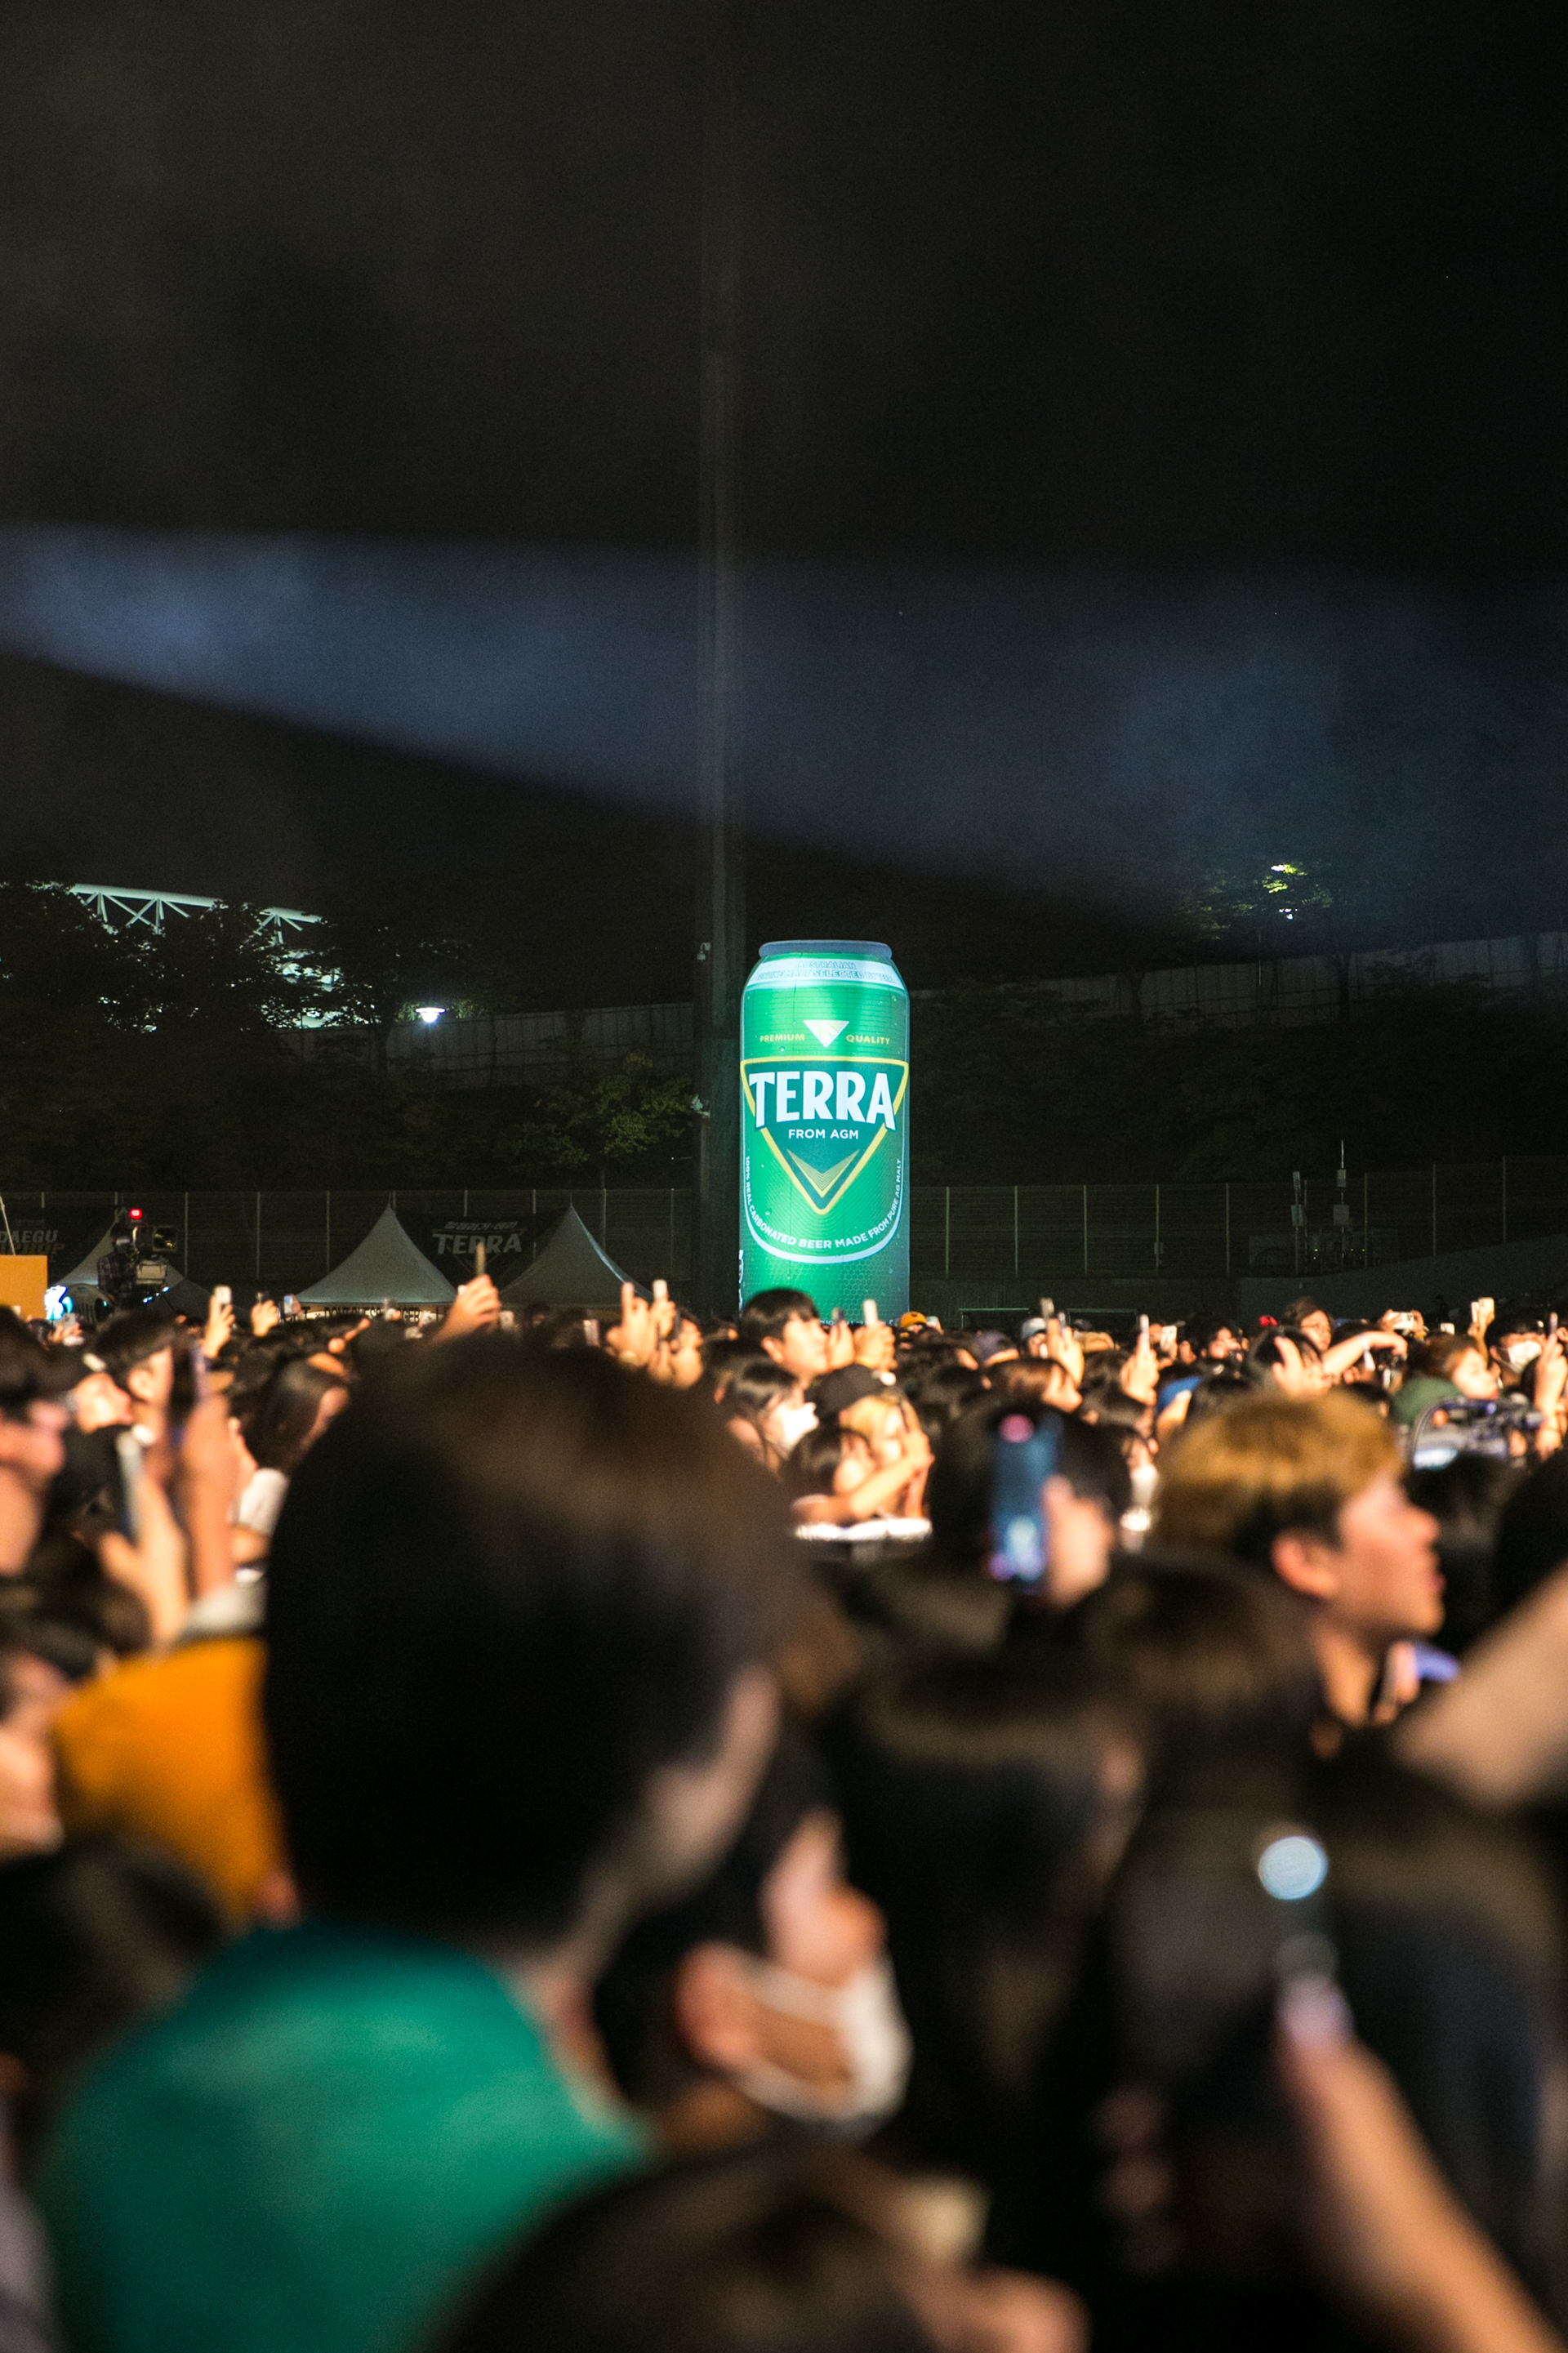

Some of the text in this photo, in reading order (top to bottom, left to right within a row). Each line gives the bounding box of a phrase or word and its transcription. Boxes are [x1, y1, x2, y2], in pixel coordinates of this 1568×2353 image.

[813, 969, 865, 979] SELECTED
[760, 1034, 890, 1045] PREMIUM QUALITY
[749, 1071, 896, 1130] TERRA
[788, 1129, 859, 1139] FROM AGM
[749, 1205, 797, 1245] CARBONATED
[799, 1238, 832, 1249] BEER
[835, 1232, 868, 1247] MADE
[867, 1218, 889, 1238] FROM
[887, 1198, 899, 1221] PURE
[895, 1184, 900, 1197] AG
[0, 1229, 58, 1243] DAEGU
[0, 1242, 65, 1254] IPHOP
